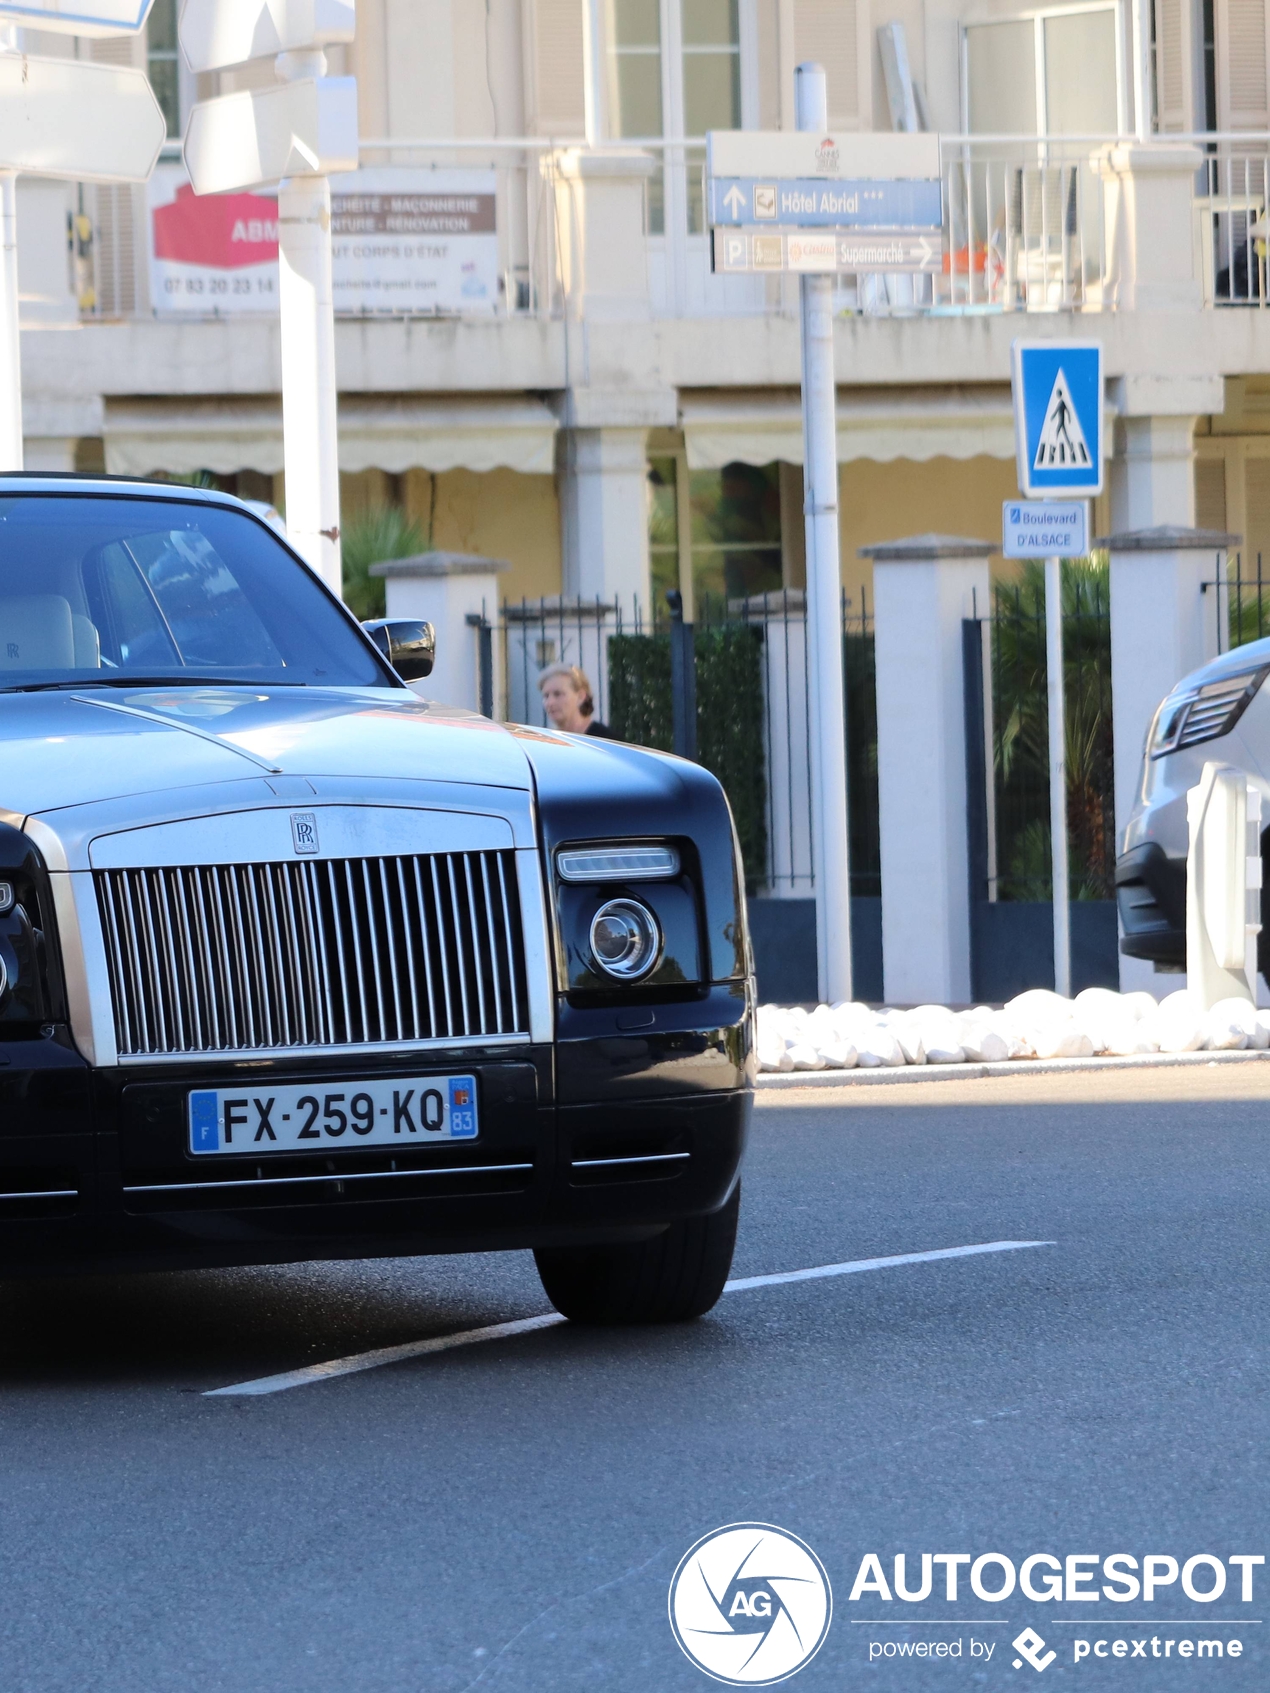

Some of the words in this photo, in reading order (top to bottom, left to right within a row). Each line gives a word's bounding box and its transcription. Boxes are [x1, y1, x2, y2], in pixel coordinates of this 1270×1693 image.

[782, 191, 816, 213] Hôtel
[819, 191, 858, 213] Abrial
[331, 216, 376, 232] NTURE
[729, 242, 742, 264] P
[841, 241, 904, 267] Supermarché
[1023, 512, 1077, 525] Boulevard
[1017, 533, 1071, 547] D'ALSACE
[201, 1127, 209, 1140] F
[223, 1088, 445, 1144] FX-259-KQ
[452, 1111, 472, 1131] 83
